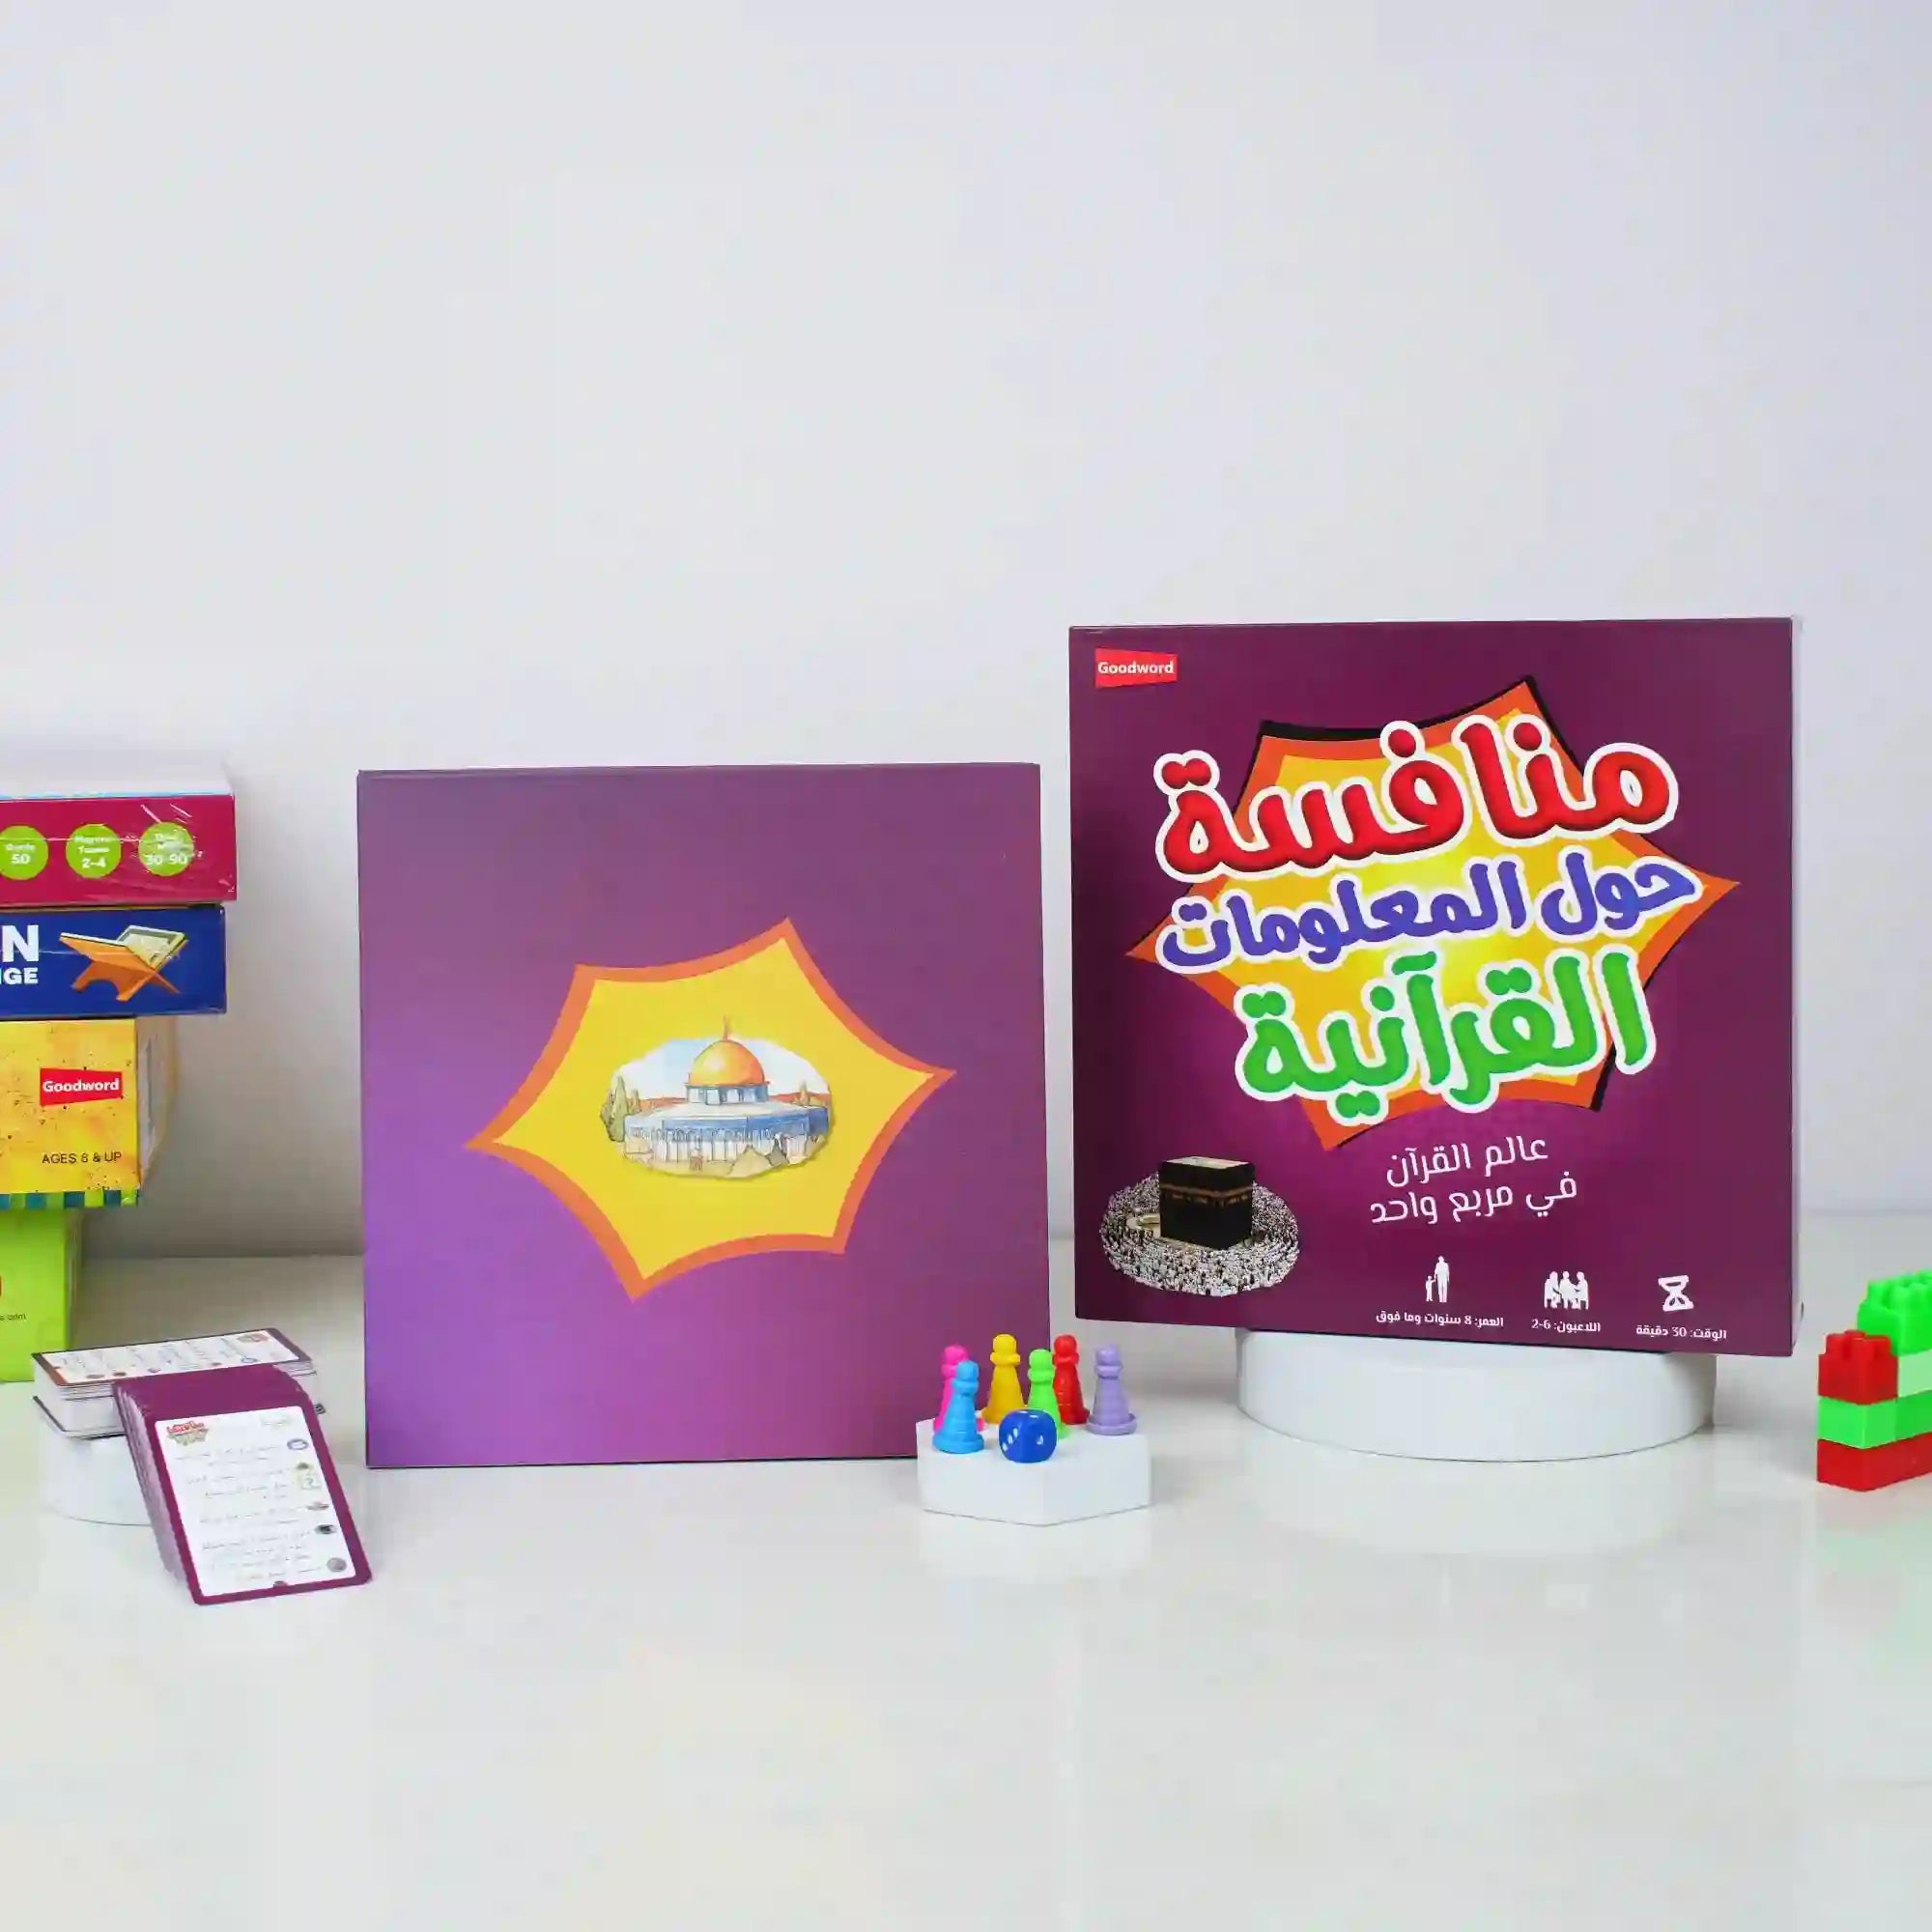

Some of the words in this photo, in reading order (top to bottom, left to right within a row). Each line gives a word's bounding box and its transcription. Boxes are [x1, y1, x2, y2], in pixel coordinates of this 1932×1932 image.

[1097, 660, 1175, 674] Goodword
[1157, 718, 1674, 875] منافسة
[12, 853, 31, 865] 50
[82, 857, 106, 869] 2-4
[1540, 850, 1698, 938] حول
[1157, 858, 1530, 969] المعلومات
[0, 967, 39, 985] GE
[1239, 947, 1652, 1122] القرآنية
[43, 1078, 119, 1093] Goodword
[42, 1153, 77, 1164] AGES
[81, 1152, 89, 1163] 8
[104, 1151, 122, 1162] UP
[1485, 1135, 1548, 1177] عالم
[1386, 1142, 1471, 1188] القرآن
[1524, 1171, 1577, 1218] في
[1370, 1191, 1438, 1225] واحد
[1449, 1183, 1514, 1223] مربع
[1376, 1310, 1401, 1323] فوق
[1404, 1312, 1421, 1324] وما
[1424, 1313, 1462, 1327] سنوات
[1463, 1315, 1472, 1325] 8
[1475, 1317, 1504, 1328] العمر:
[1553, 1321, 1601, 1333] اللاعبون:
[1635, 1324, 1669, 1338] دقيقة
[1672, 1326, 1688, 1338] 30
[1690, 1327, 1727, 1342] الوقت:
